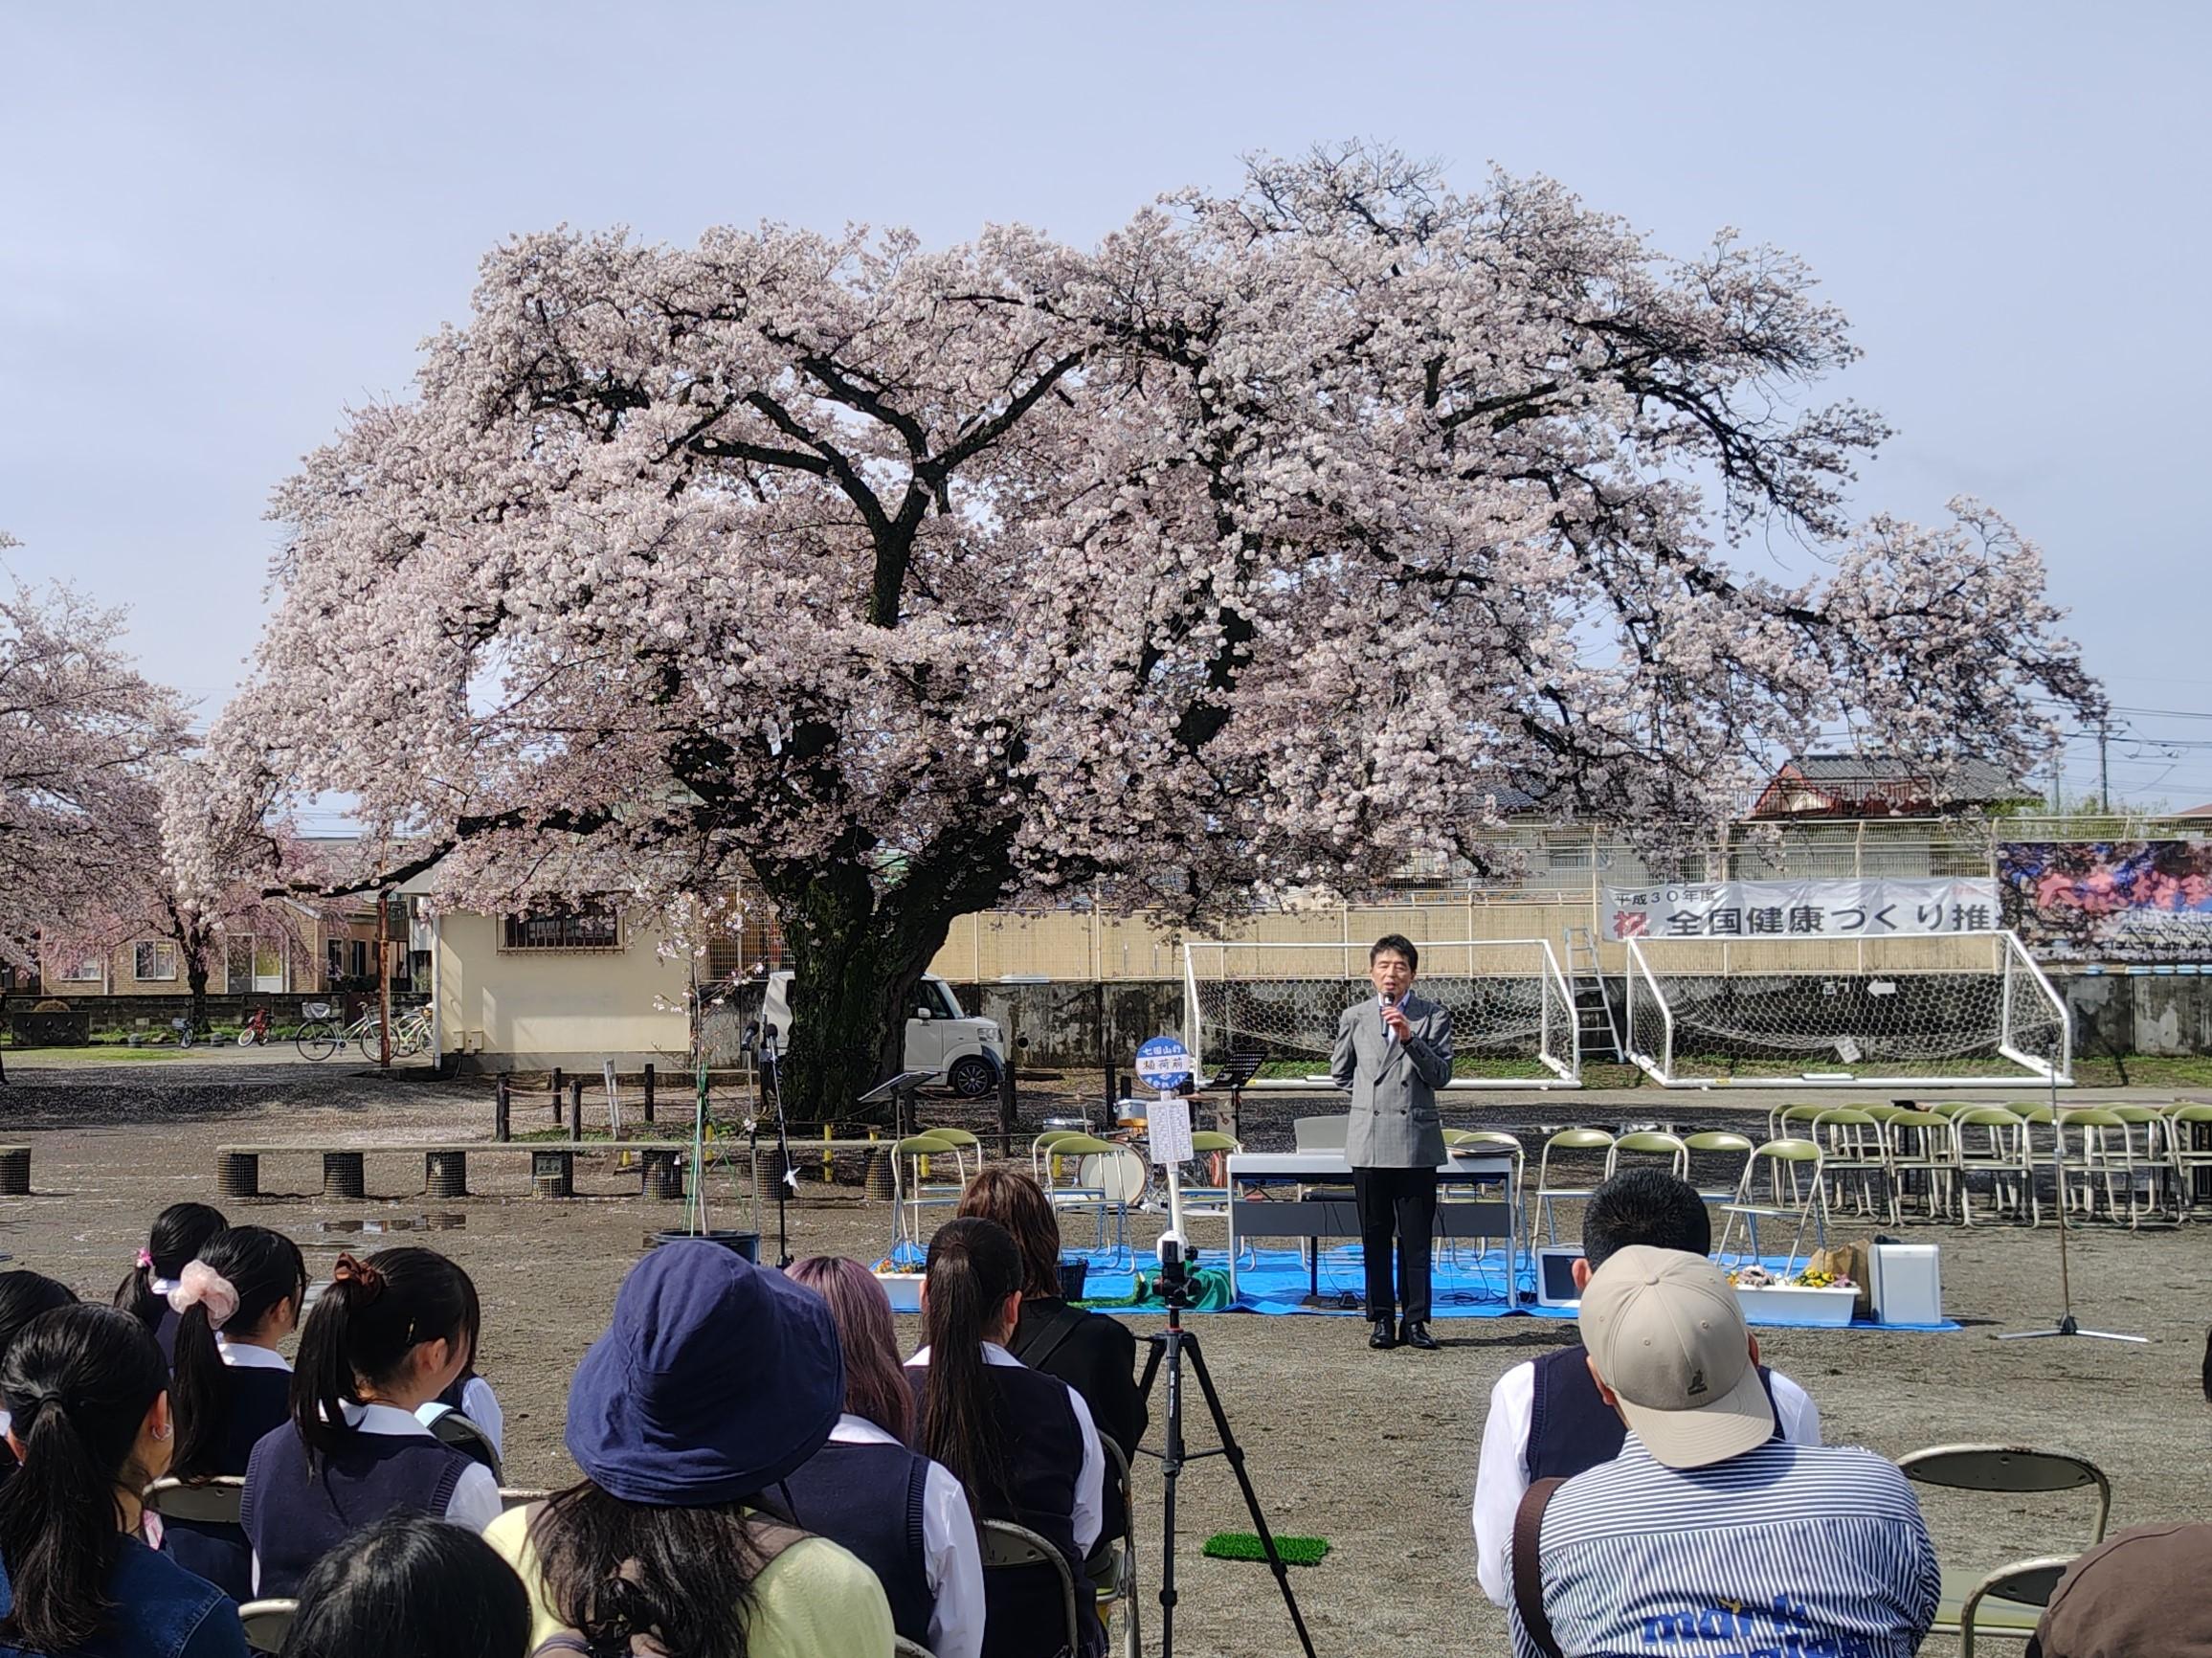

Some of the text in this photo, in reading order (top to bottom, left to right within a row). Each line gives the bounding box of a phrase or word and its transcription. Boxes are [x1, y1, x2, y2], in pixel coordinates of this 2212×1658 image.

[1613, 903, 2005, 939] 祝 全国健康づくり推
